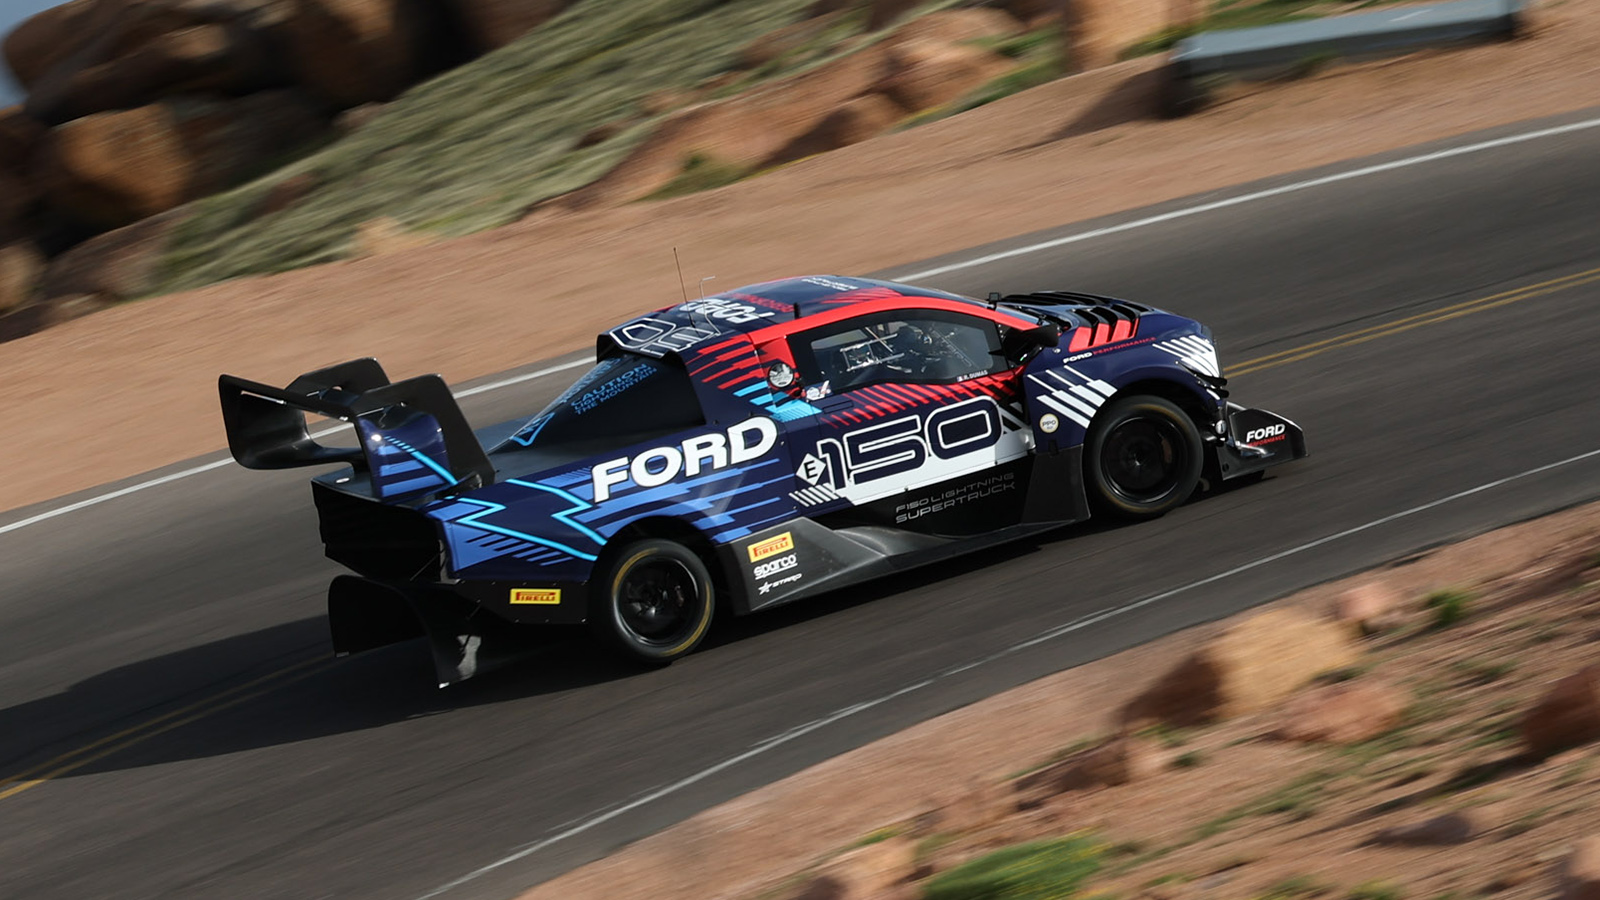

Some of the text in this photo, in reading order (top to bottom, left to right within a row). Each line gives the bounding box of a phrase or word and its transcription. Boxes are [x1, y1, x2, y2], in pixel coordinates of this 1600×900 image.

[1063, 337, 1157, 364] FORD PERFORMANCE
[571, 363, 647, 406] CAUTION
[575, 402, 598, 415] THE
[600, 367, 658, 403] MOUNTAIN
[816, 395, 1004, 493] 150
[1246, 423, 1286, 443] FORD
[592, 416, 778, 503] FORD
[803, 460, 819, 480] E
[895, 481, 1016, 525] SUPERTRUCK
[752, 536, 789, 558] PIRELLI
[753, 553, 798, 580] sparco
[515, 591, 556, 602] PIRELLI
